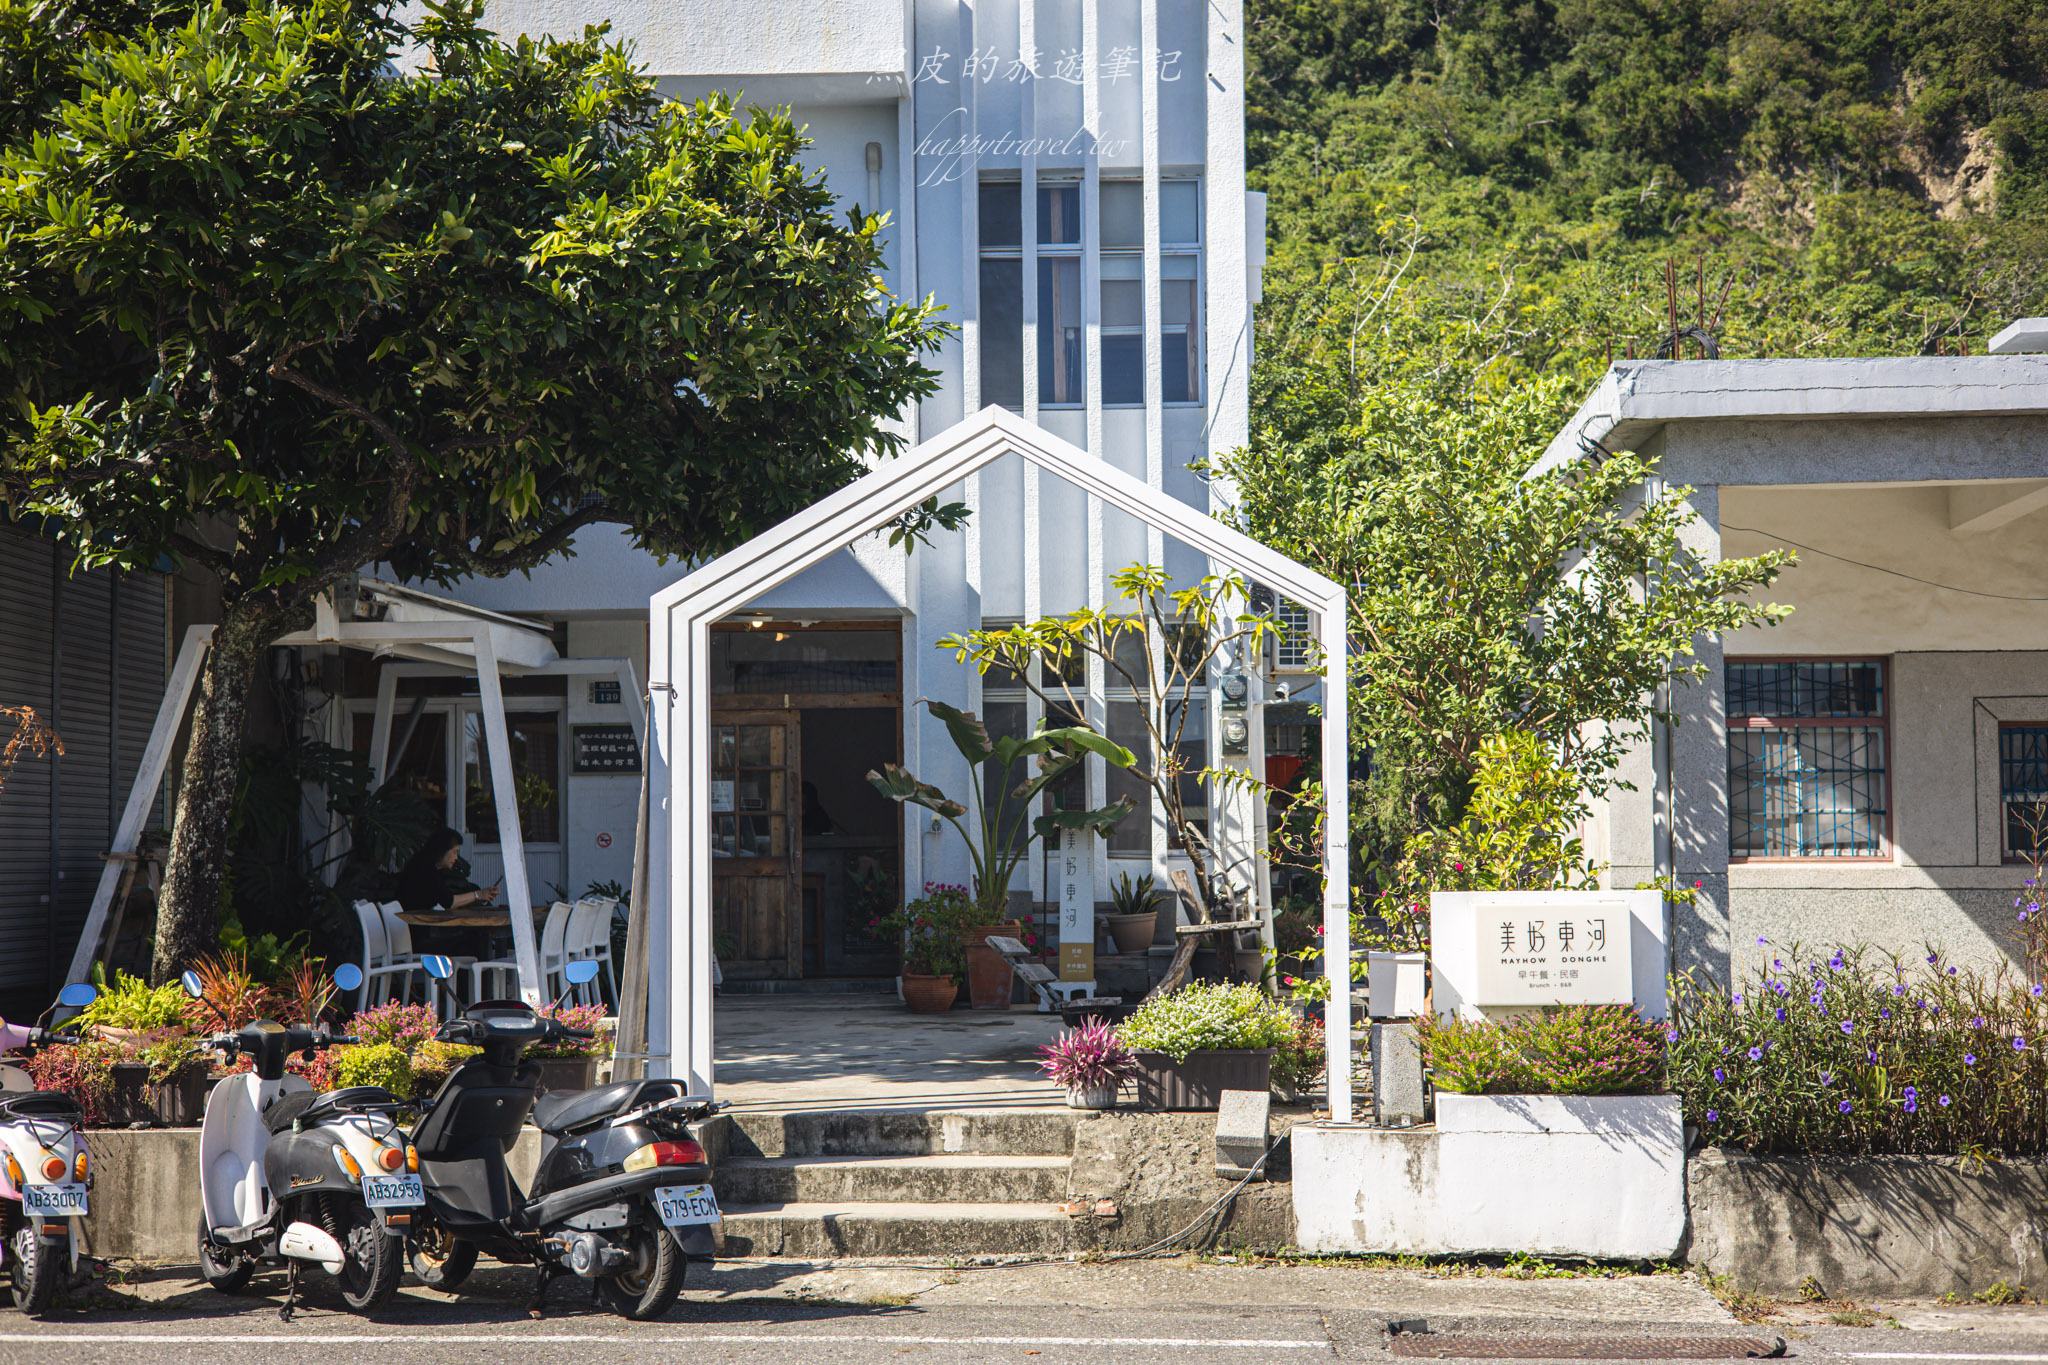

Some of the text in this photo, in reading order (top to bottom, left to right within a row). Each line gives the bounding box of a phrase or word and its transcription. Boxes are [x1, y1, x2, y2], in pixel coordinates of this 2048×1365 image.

[1066, 831, 1077, 928] 美好東河
[1500, 919, 1605, 954] 美好東河
[1501, 955, 1607, 965] MAYHOW DONGHE
[27, 1192, 83, 1208] AB33007
[368, 1182, 421, 1200] AB32959
